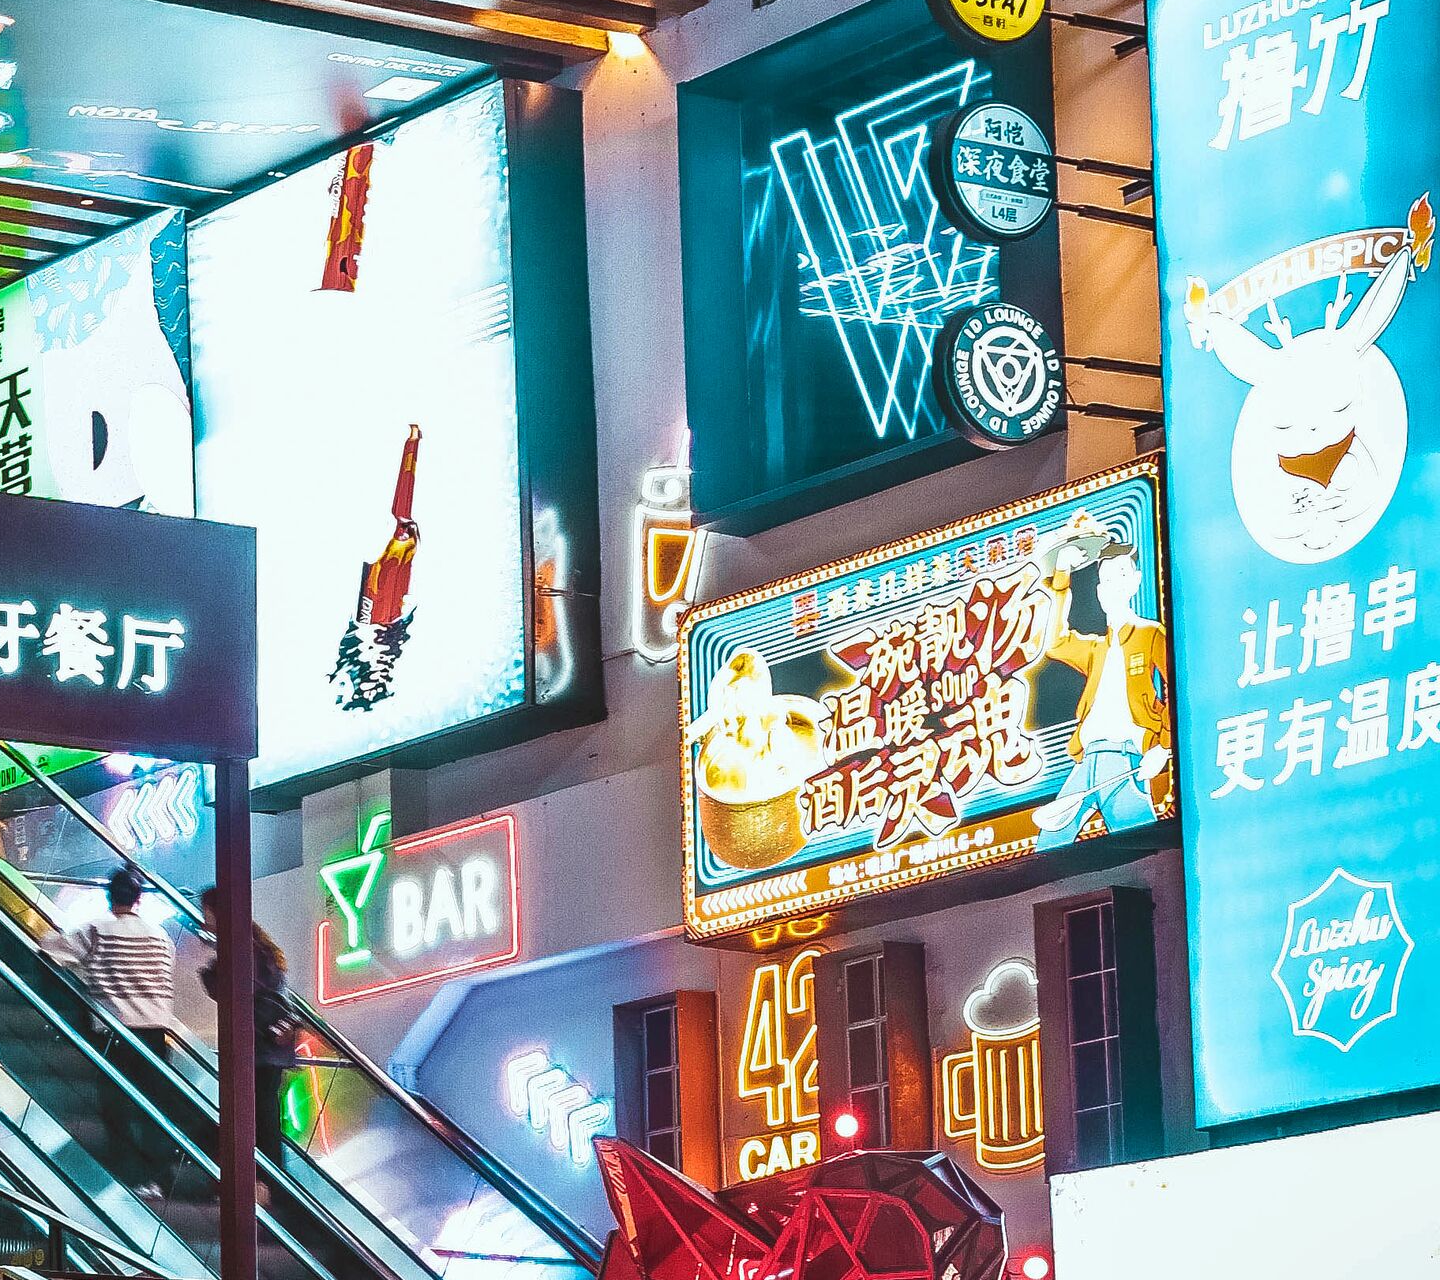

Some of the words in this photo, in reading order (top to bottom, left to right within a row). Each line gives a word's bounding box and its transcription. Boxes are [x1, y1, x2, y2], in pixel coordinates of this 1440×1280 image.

[956, 146, 1050, 193] 深夜食堂
[964, 318, 983, 340] ID
[984, 308, 1044, 340] LOUNGE
[956, 349, 988, 419] LOUNGE
[1043, 349, 1060, 372] ID
[988, 416, 1008, 434] ID
[1021, 379, 1061, 435] LOUNGE
[930, 664, 979, 714] SOUP
[391, 856, 501, 956] BAR
[1289, 890, 1394, 959] Luzhu
[1302, 955, 1386, 1030] Spicy
